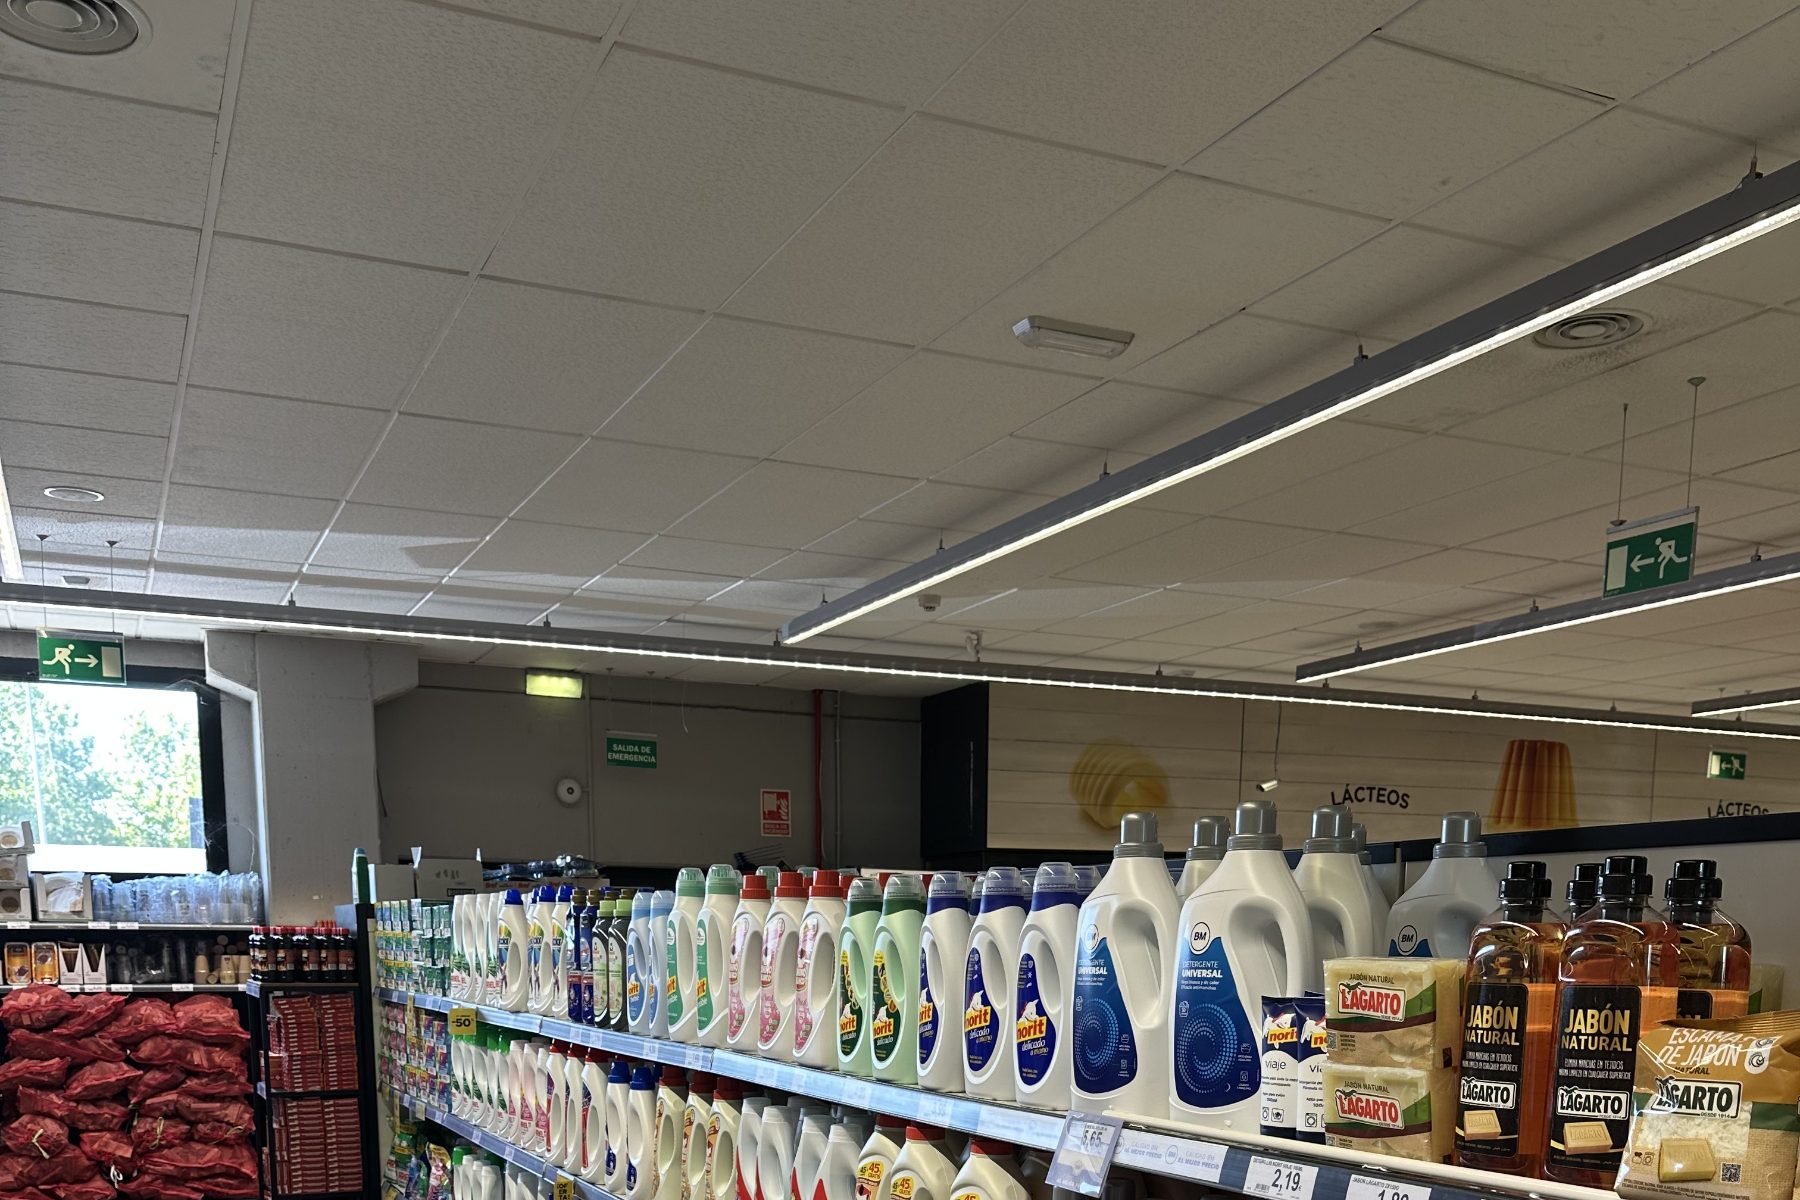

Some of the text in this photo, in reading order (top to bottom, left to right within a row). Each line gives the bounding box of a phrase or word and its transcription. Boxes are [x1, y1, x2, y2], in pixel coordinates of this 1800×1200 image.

[613, 744, 651, 753] SALIDA DE
[608, 752, 656, 763] EMERGENCIA
[1331, 784, 1410, 809] LÁCTEOS
[1194, 932, 1207, 941] BM
[1401, 934, 1415, 944] BM
[1182, 969, 1223, 978] UNIVERSAL
[1368, 974, 1394, 984] NATURAL
[1340, 987, 1401, 1016] LAGARTO
[1467, 1001, 1518, 1030] JABÓN
[1564, 1003, 1630, 1035] JABÓN
[969, 1028, 990, 1039] delicado
[1017, 1018, 1046, 1040] norit
[1021, 1039, 1046, 1051] delicado
[1465, 1029, 1520, 1046] NATURAL
[1561, 1036, 1632, 1051] NATURAL
[1659, 1041, 1742, 1067] DE JABÓN
[1265, 1060, 1286, 1071] viaje
[1462, 1084, 1511, 1104] LAGARTO
[1657, 1083, 1733, 1112] LAGARTO
[1338, 1095, 1399, 1123] LAGARTO
[1560, 1092, 1623, 1114] LAGARTO
[869, 1163, 880, 1173] 45
[900, 1179, 911, 1189] 45
